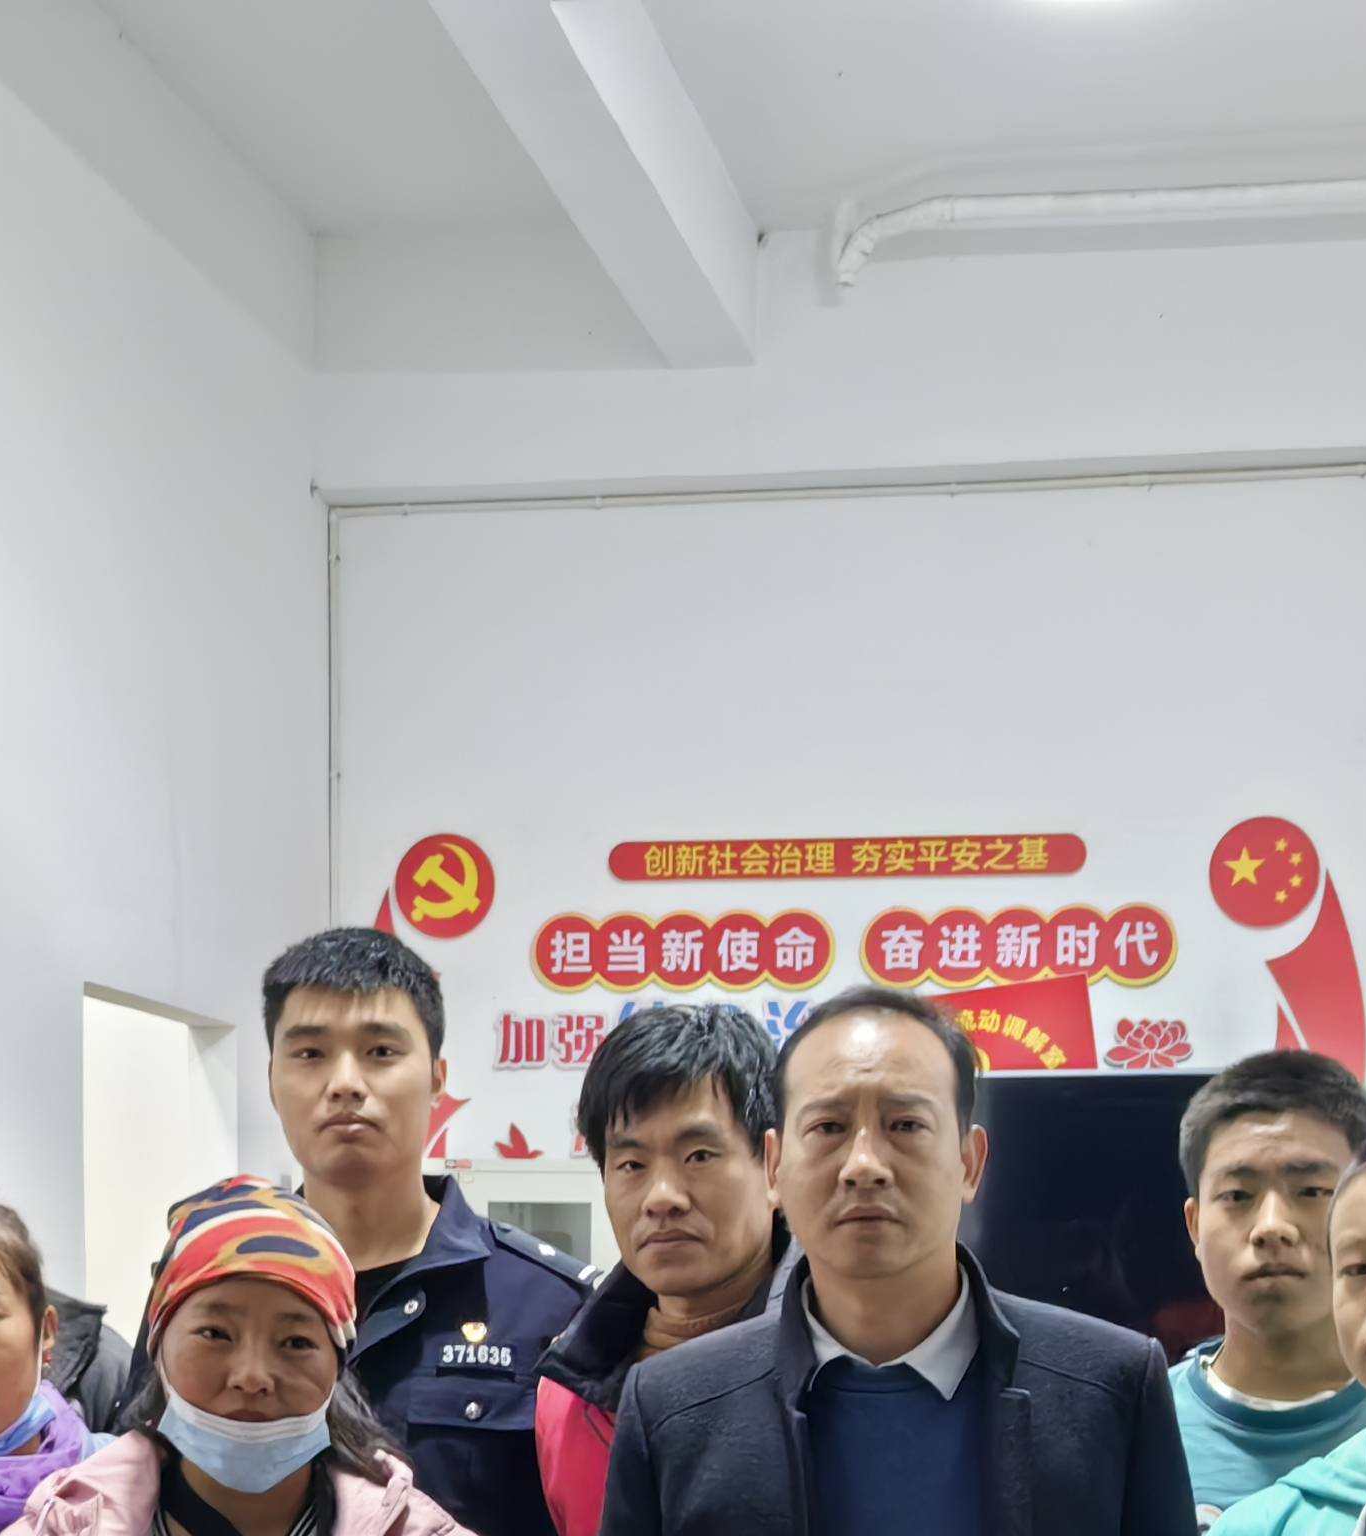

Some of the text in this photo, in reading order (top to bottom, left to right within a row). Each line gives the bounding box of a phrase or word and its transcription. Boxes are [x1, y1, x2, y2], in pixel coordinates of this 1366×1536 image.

[644, 837, 1050, 877] 创新社会治理 夯实平安之基
[550, 921, 1160, 975] 担当新使命 奋进新时代
